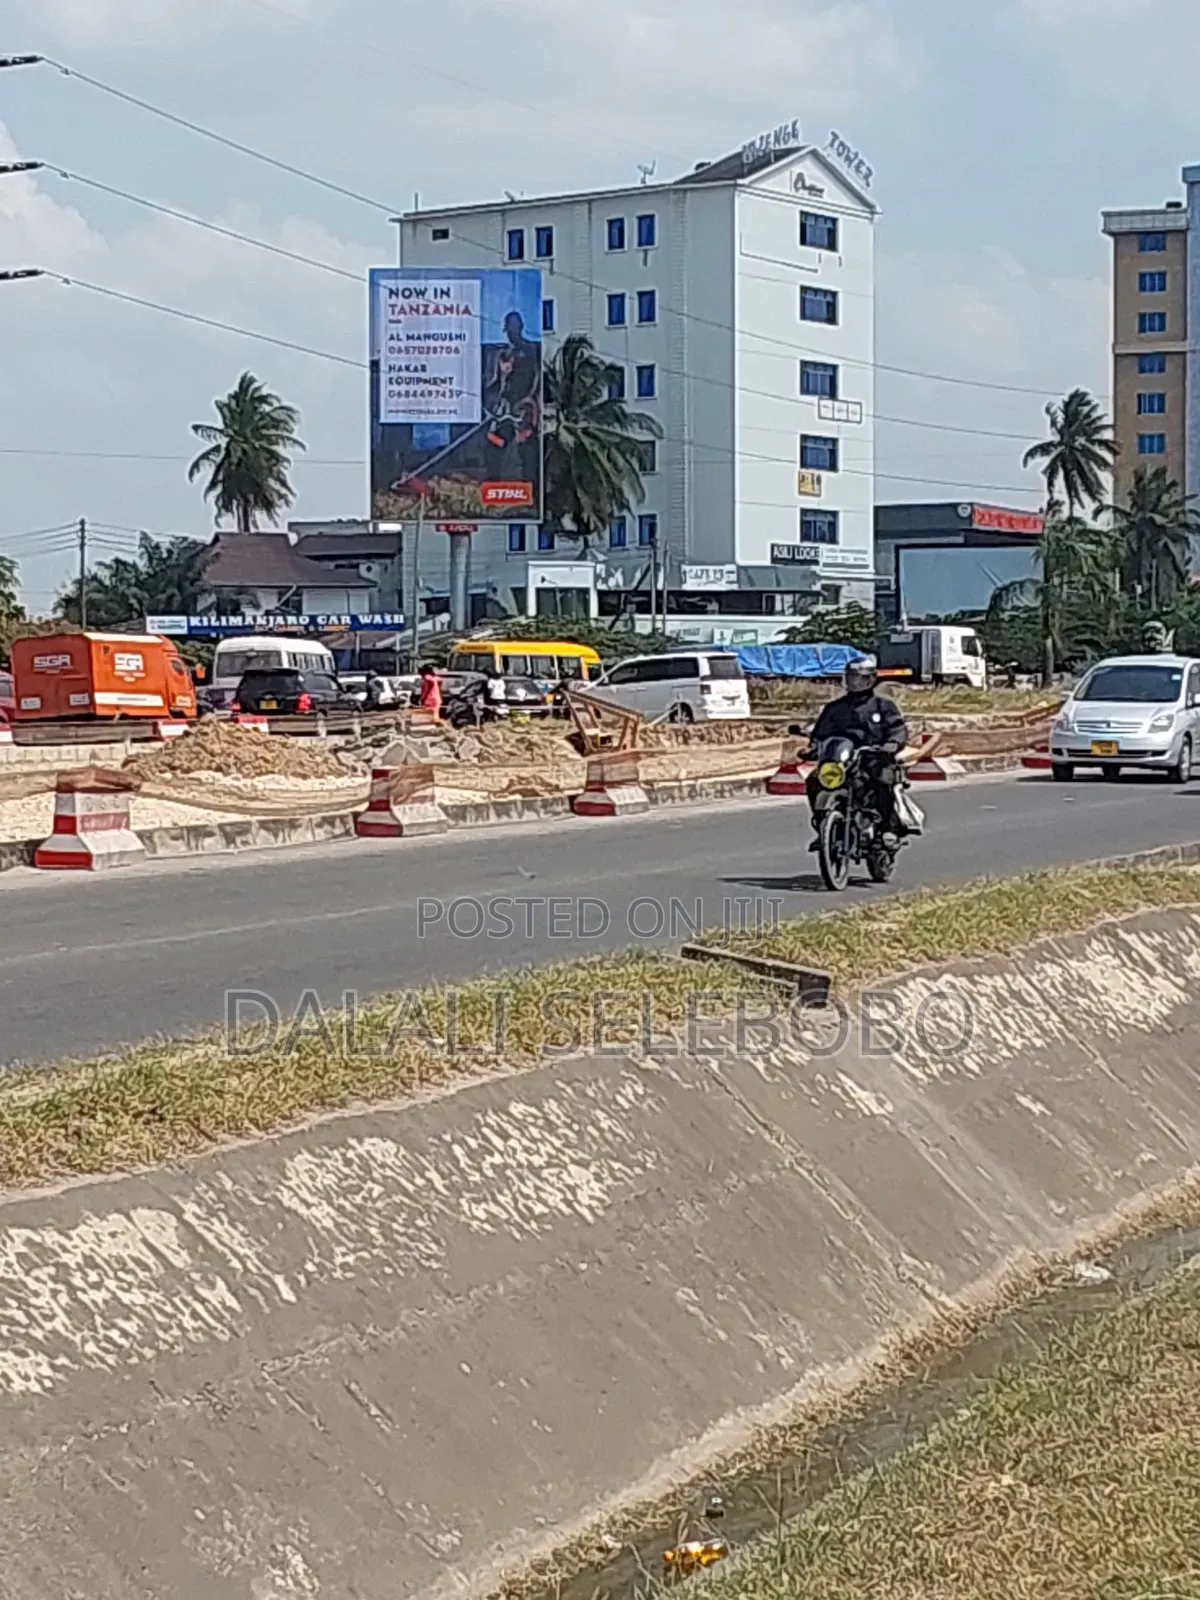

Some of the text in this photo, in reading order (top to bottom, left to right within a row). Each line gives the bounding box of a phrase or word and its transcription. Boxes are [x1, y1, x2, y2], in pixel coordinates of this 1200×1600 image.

[829, 130, 873, 187] TOWER
[388, 287, 451, 299] NOW IN
[388, 304, 472, 316] TANZANIA
[388, 332, 403, 341] AL
[190, 615, 309, 627] KILIMANJARO
[317, 615, 351, 625] CAR
[358, 613, 405, 625] WASH
[34, 655, 71, 668] SGA
[114, 653, 143, 671] SGA
